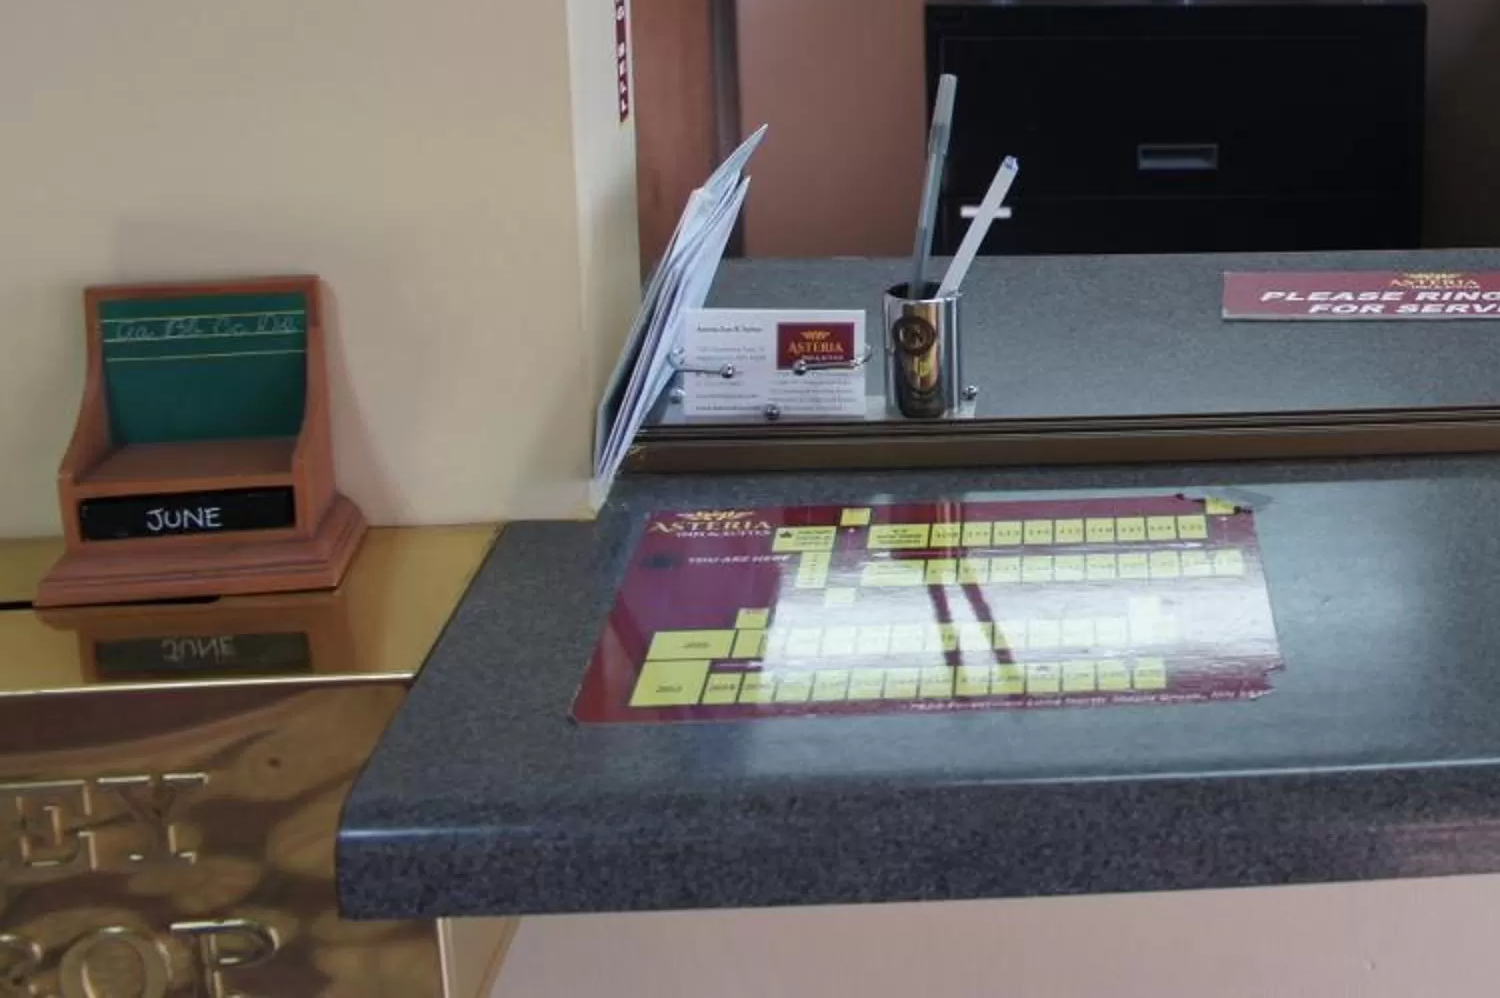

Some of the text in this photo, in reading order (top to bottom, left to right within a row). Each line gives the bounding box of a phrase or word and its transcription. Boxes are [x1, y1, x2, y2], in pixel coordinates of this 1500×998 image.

[1260, 291, 1405, 302] PLEASE
[1307, 303, 1386, 314] FOR
[787, 340, 845, 354] ASTERIA
[146, 507, 225, 531] JUNE
[648, 520, 772, 534] ASTERIA
